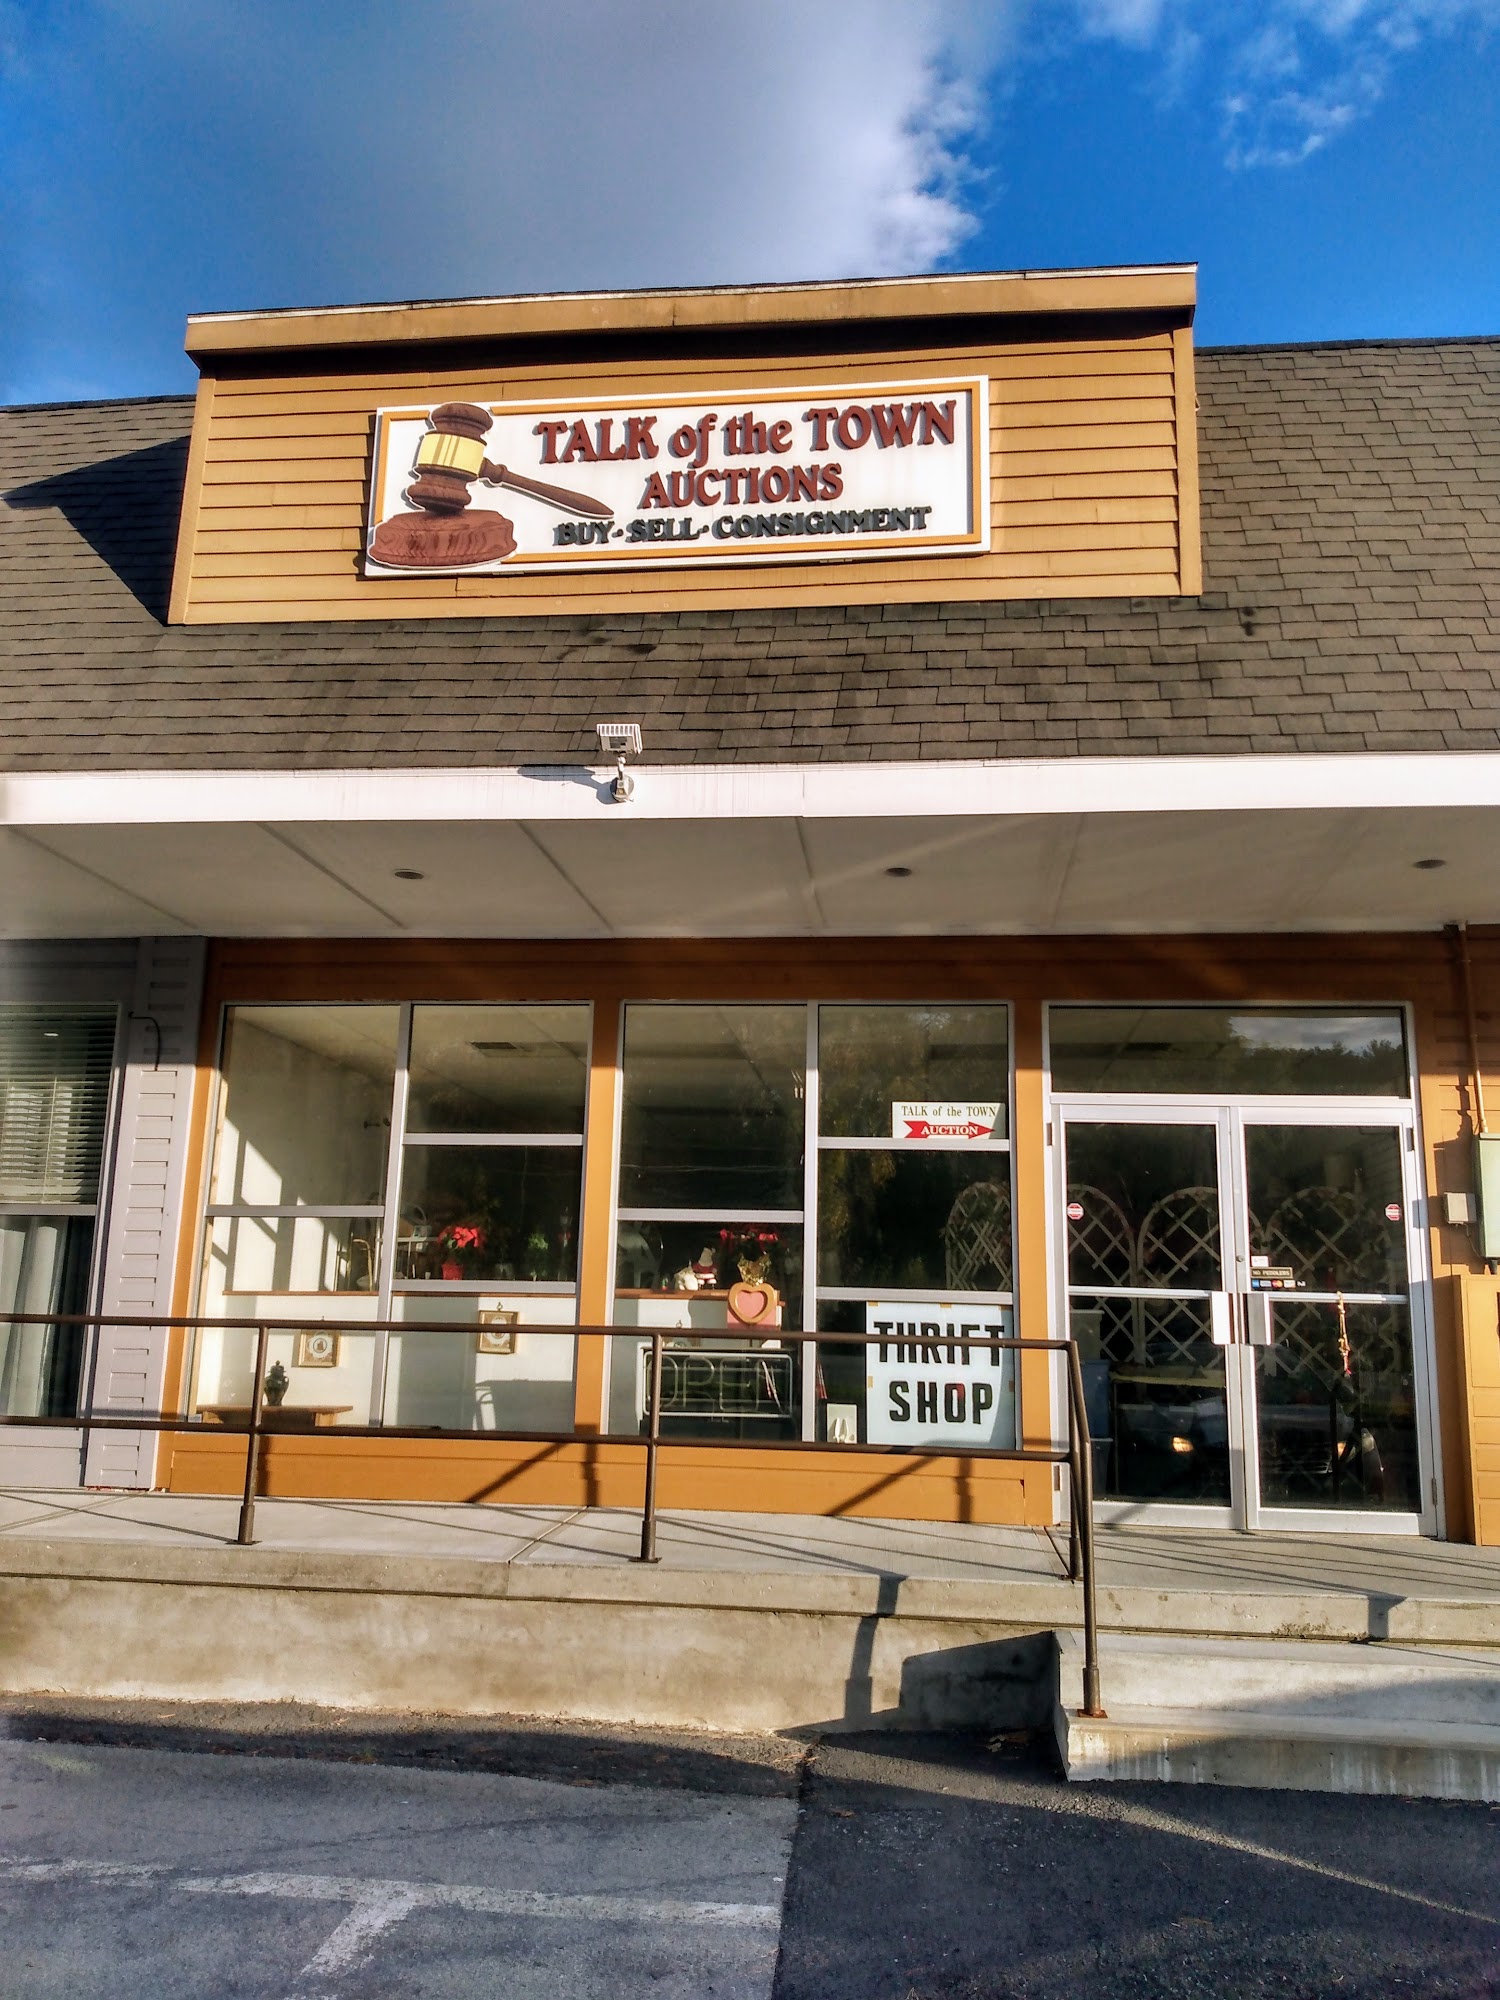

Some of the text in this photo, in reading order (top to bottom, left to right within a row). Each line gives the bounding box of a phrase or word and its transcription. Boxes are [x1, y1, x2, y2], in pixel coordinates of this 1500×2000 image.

[535, 399, 957, 469] TALK of the TOWN
[638, 462, 844, 510] AUCTIONS
[554, 505, 932, 547] BUY SELL CONSIGNMENT
[901, 1105, 997, 1118] TALK of the TOWN
[920, 1125, 979, 1136] AUCTION
[873, 1321, 1005, 1367] THRIFT
[888, 1380, 993, 1425] SHOP
